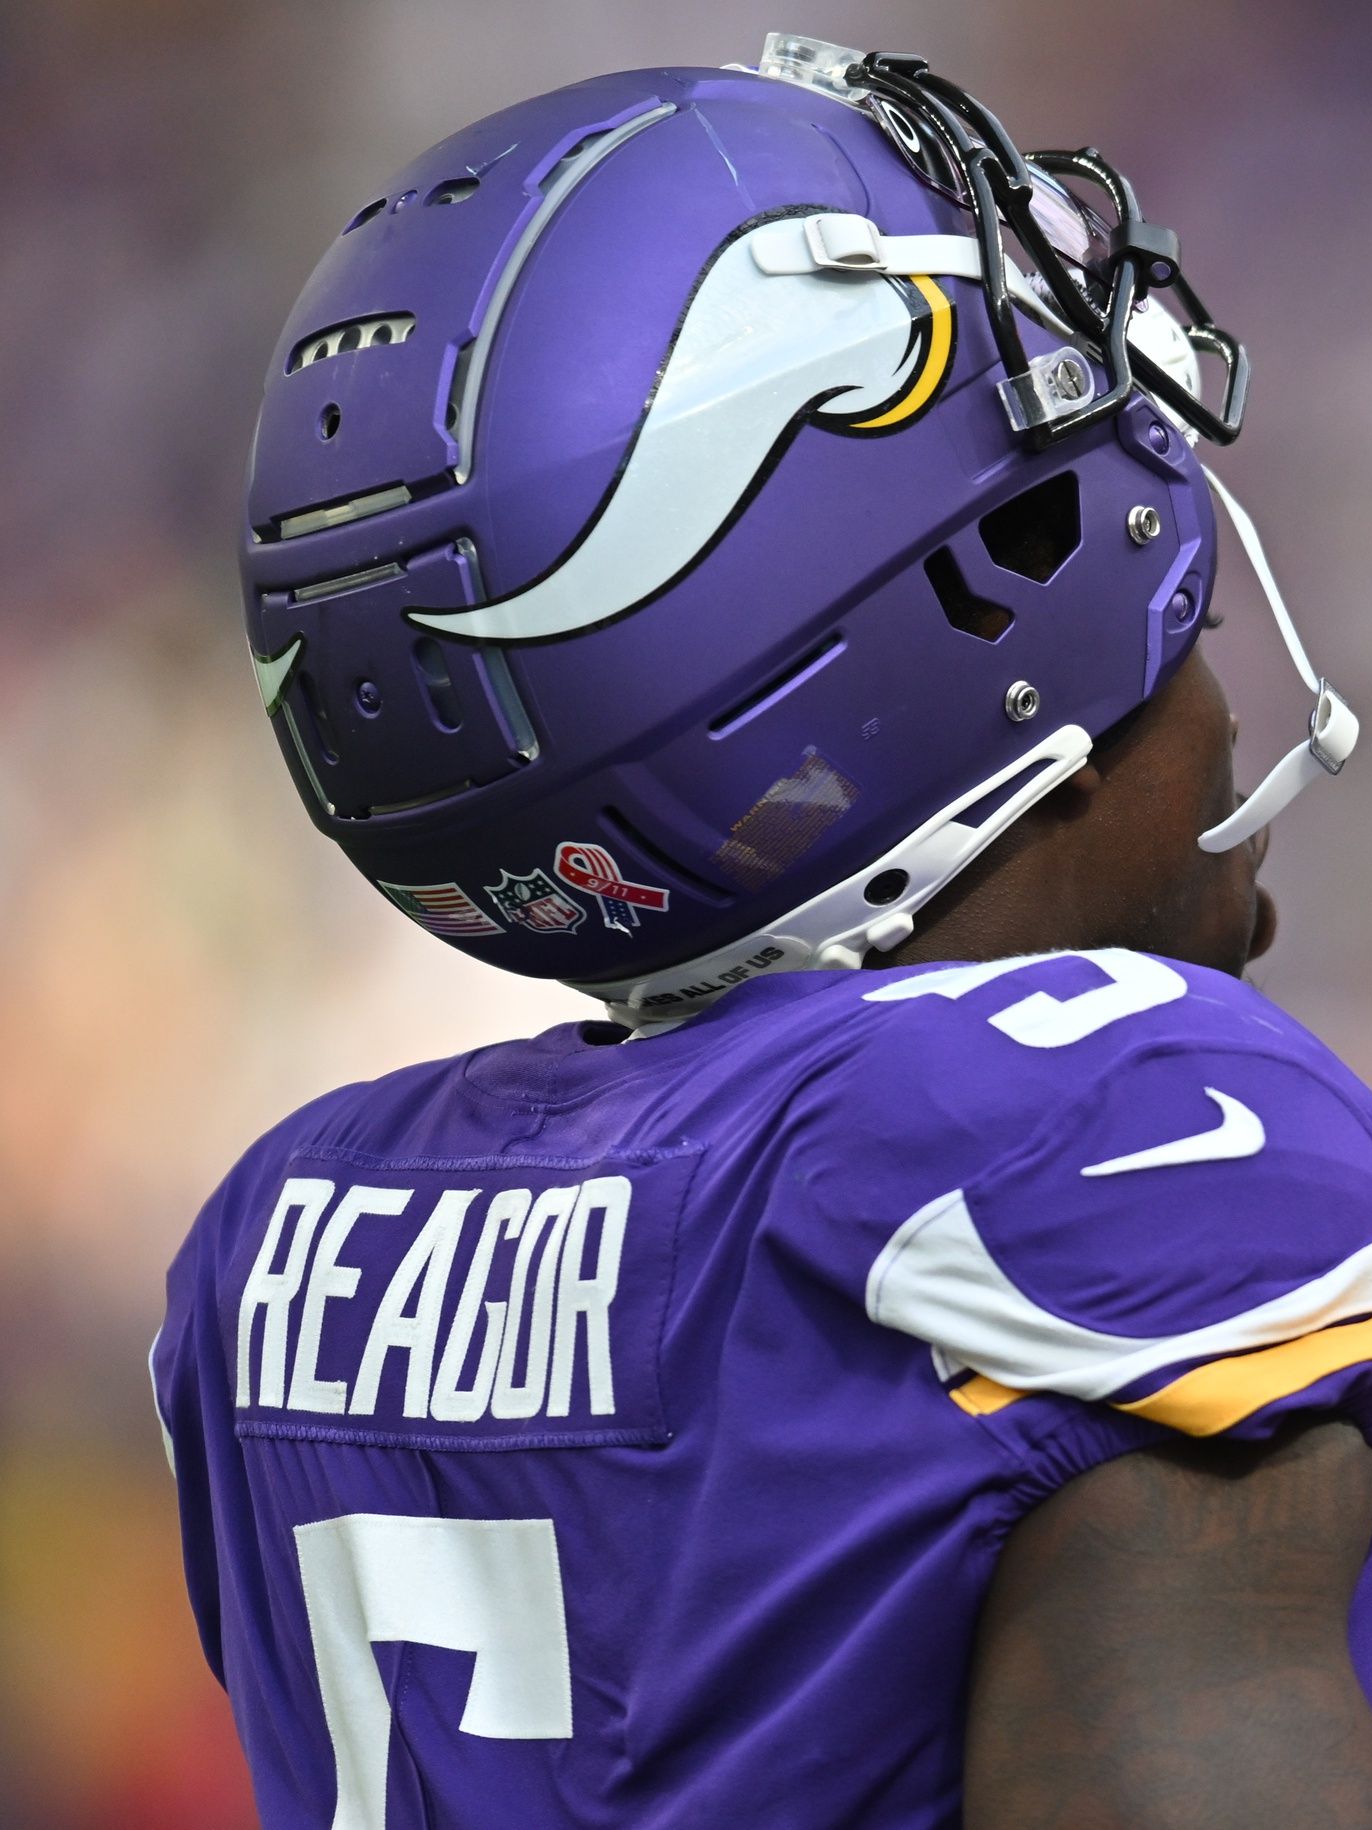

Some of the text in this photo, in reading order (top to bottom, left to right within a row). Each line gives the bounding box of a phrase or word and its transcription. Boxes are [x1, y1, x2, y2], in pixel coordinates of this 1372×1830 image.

[586, 877, 630, 898] 9/11
[680, 981, 727, 999] ALL
[717, 966, 750, 985] OF
[745, 946, 786, 969] US
[235, 1175, 633, 1422] REAGOR
